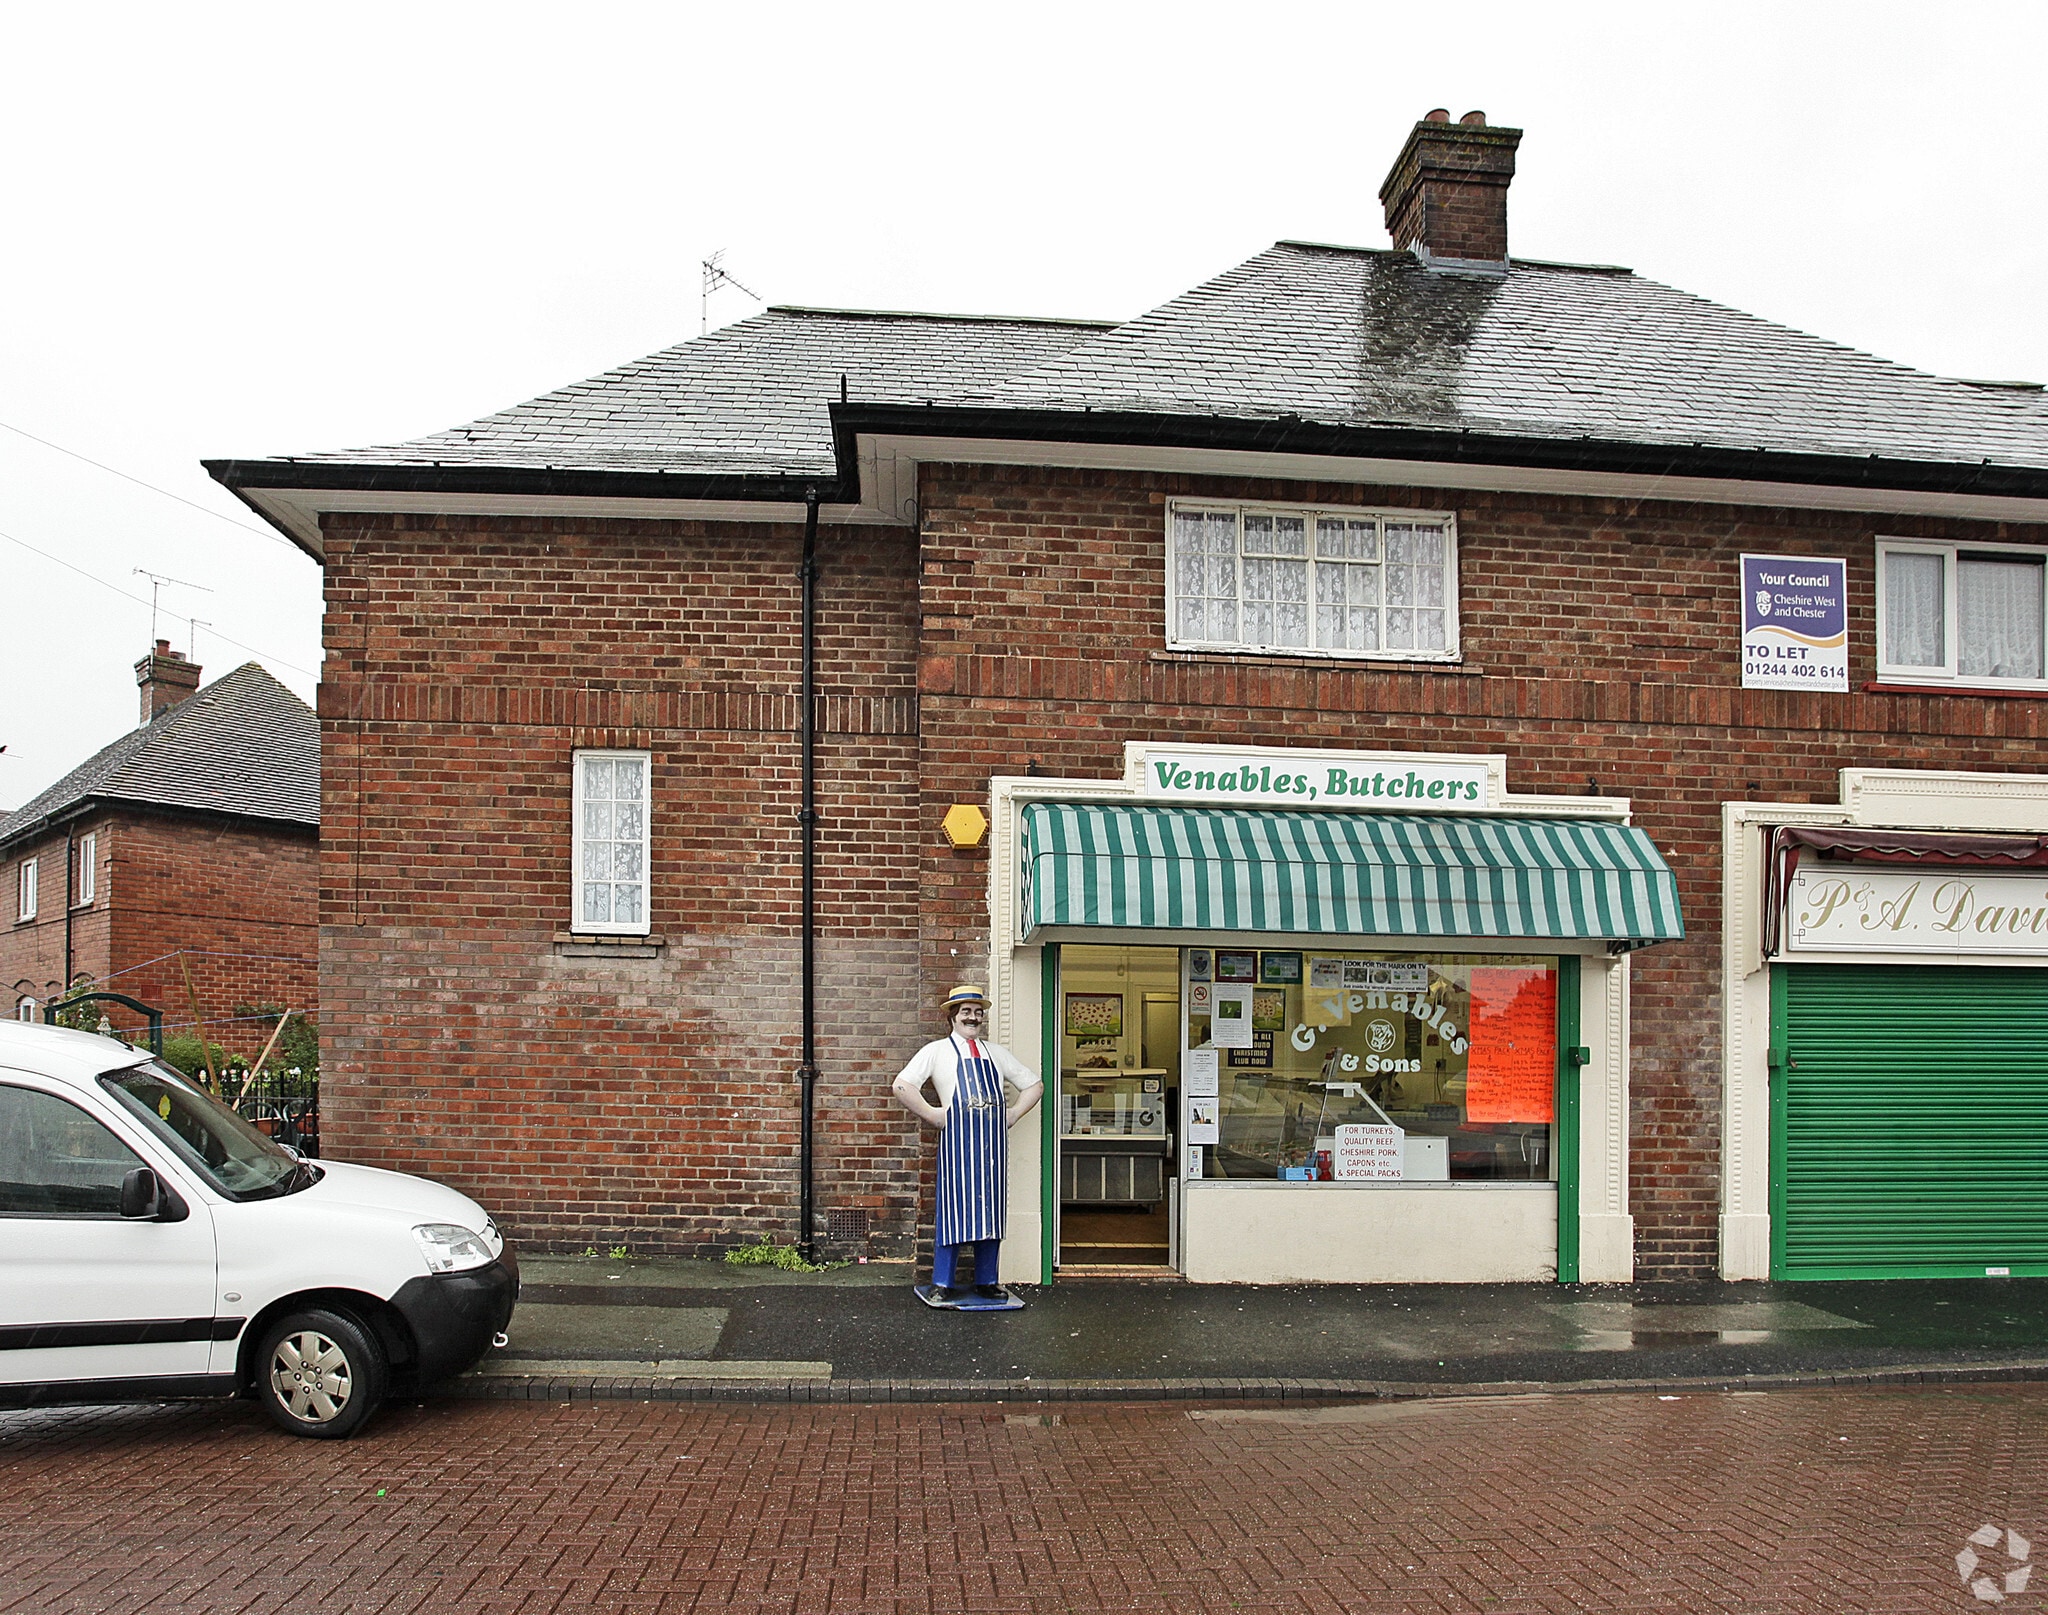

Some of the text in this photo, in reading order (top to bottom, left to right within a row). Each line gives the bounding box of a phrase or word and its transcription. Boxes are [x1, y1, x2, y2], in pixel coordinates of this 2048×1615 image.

[1760, 573, 1829, 587] Your Council
[1774, 594, 1836, 607] Cheshire West
[1774, 607, 1826, 618] and Chester
[1746, 645, 1808, 659] TO LET
[1746, 662, 1845, 678] 01244 402 614
[1154, 761, 1479, 800] Venables, Butchers
[1931, 880, 2048, 934] Davi
[1344, 960, 1361, 968] LOOK
[1388, 961, 1406, 970] MARK
[1291, 1023, 1327, 1052] G.
[1321, 991, 1469, 1056] Venables
[1340, 1054, 1421, 1073] & Sons
[1344, 1138, 1373, 1146] QUALITY
[1340, 1148, 1375, 1156] CHESHIRE
[1347, 1159, 1375, 1167] CAPONS
[1346, 1169, 1375, 1177] SPECIAL
